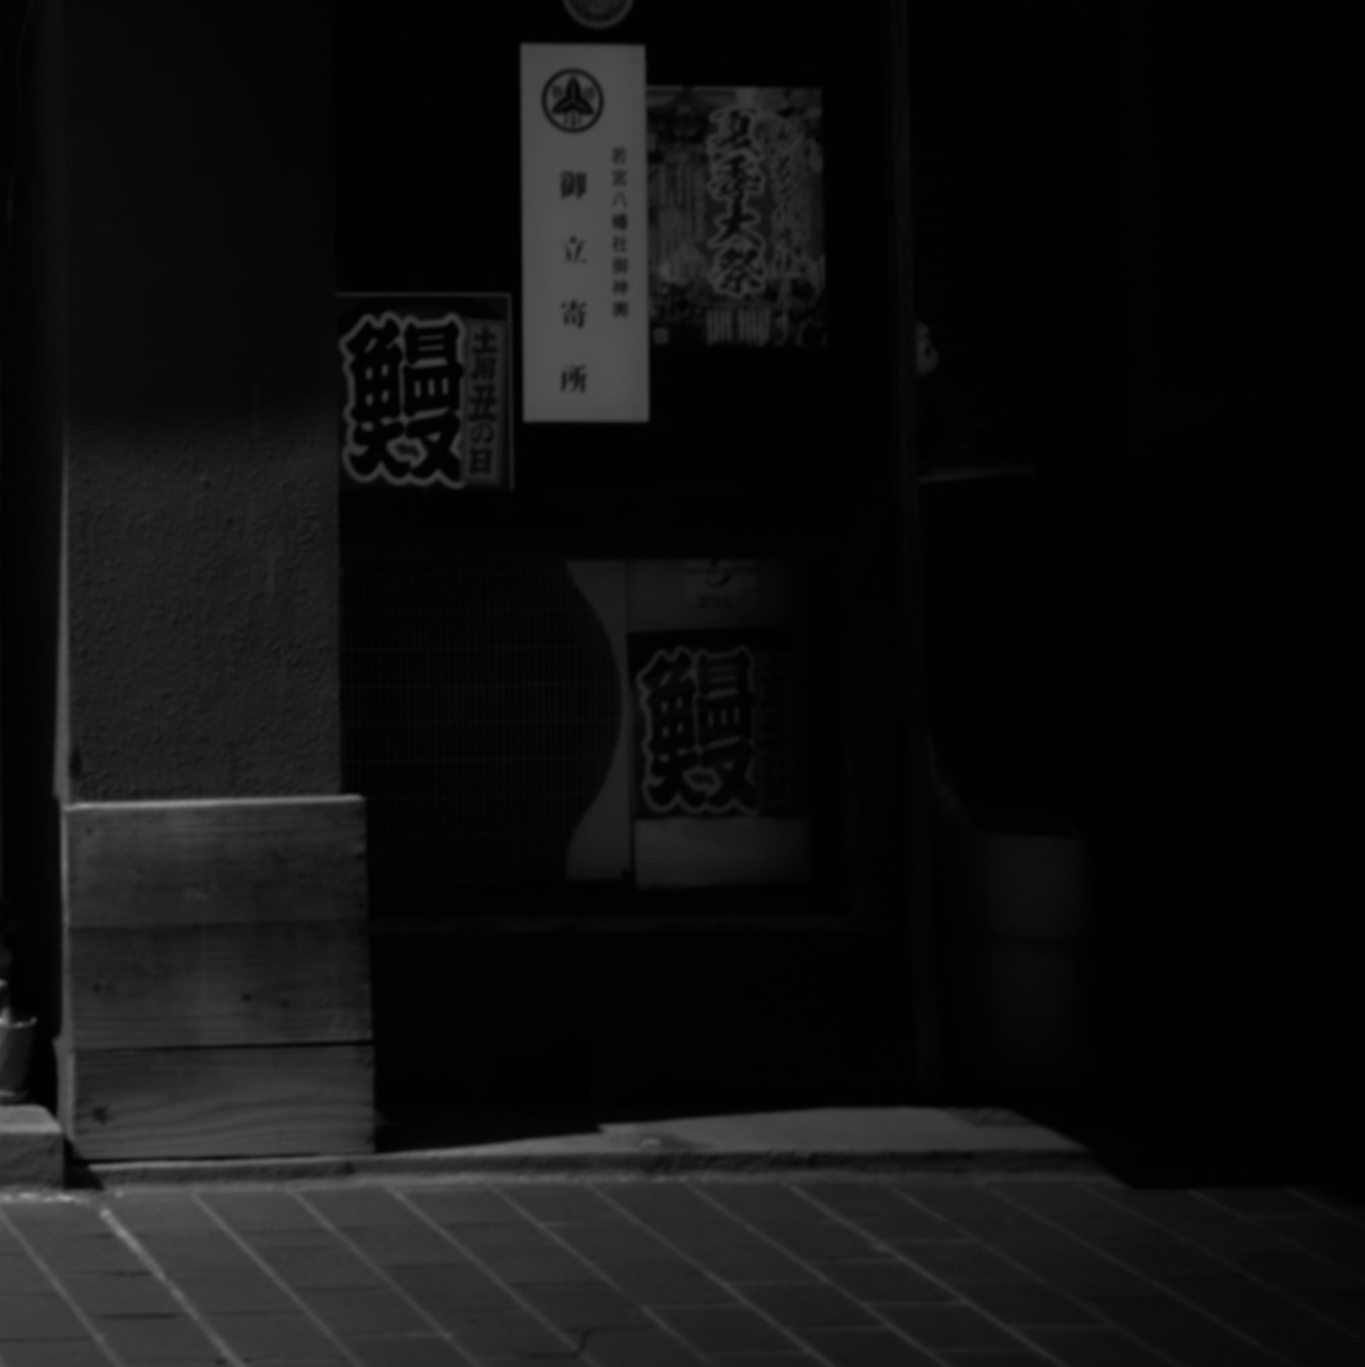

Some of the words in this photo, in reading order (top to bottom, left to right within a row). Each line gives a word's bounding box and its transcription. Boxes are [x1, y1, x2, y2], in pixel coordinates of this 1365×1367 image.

[559, 169, 588, 395] 御立寄所
[339, 311, 465, 488] 鰻
[468, 326, 499, 474] 土用丑の日
